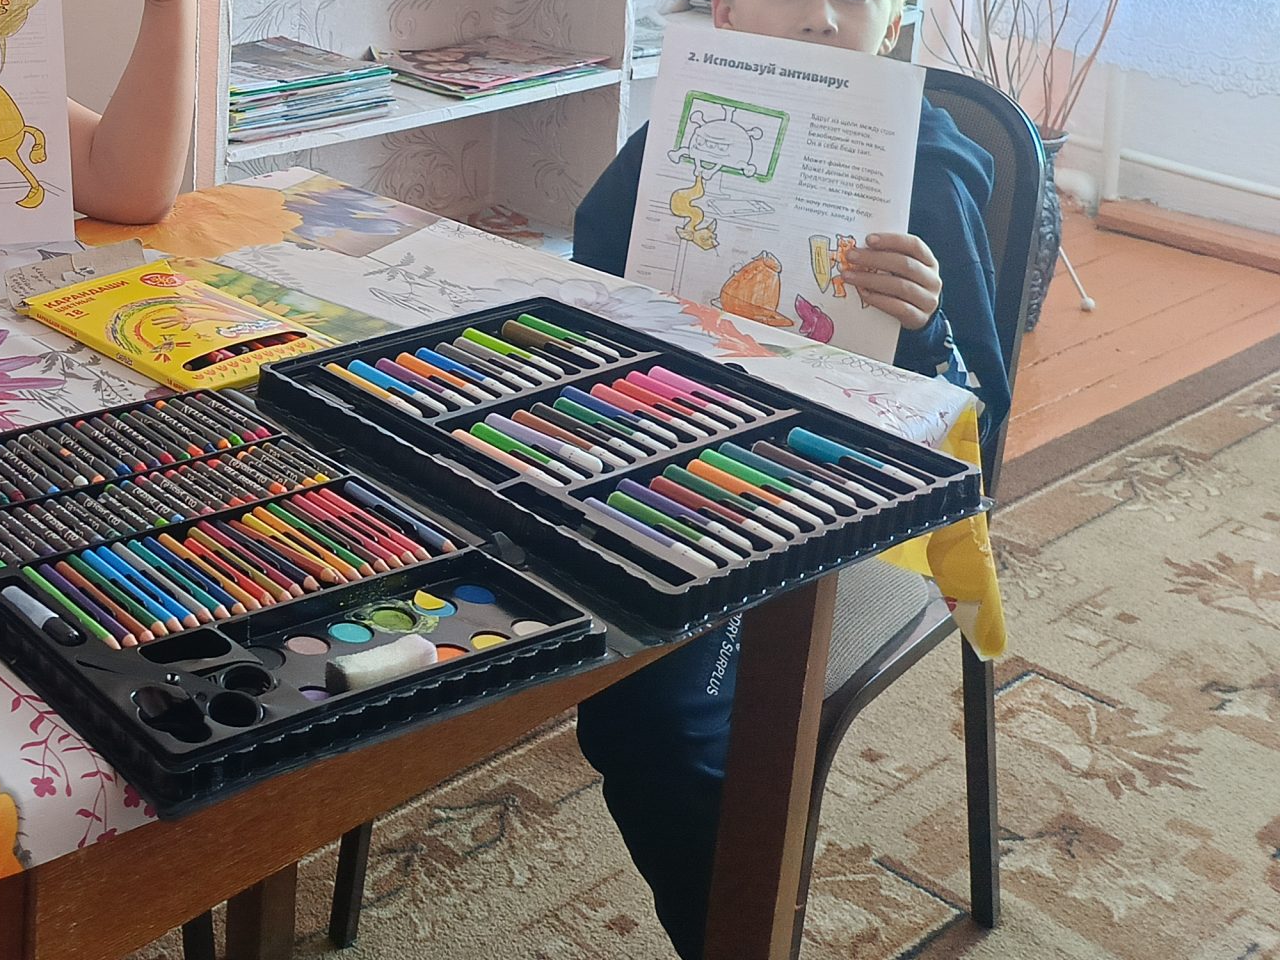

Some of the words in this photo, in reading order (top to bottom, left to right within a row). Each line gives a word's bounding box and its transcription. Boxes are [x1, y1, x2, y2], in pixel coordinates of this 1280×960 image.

[688, 52, 699, 62] 2.
[704, 53, 776, 75] Используй
[779, 68, 849, 89] антивирус
[43, 280, 129, 310] КАРАНДАШИ
[65, 308, 84, 318] 18
[706, 641, 734, 696] SURPLUS
